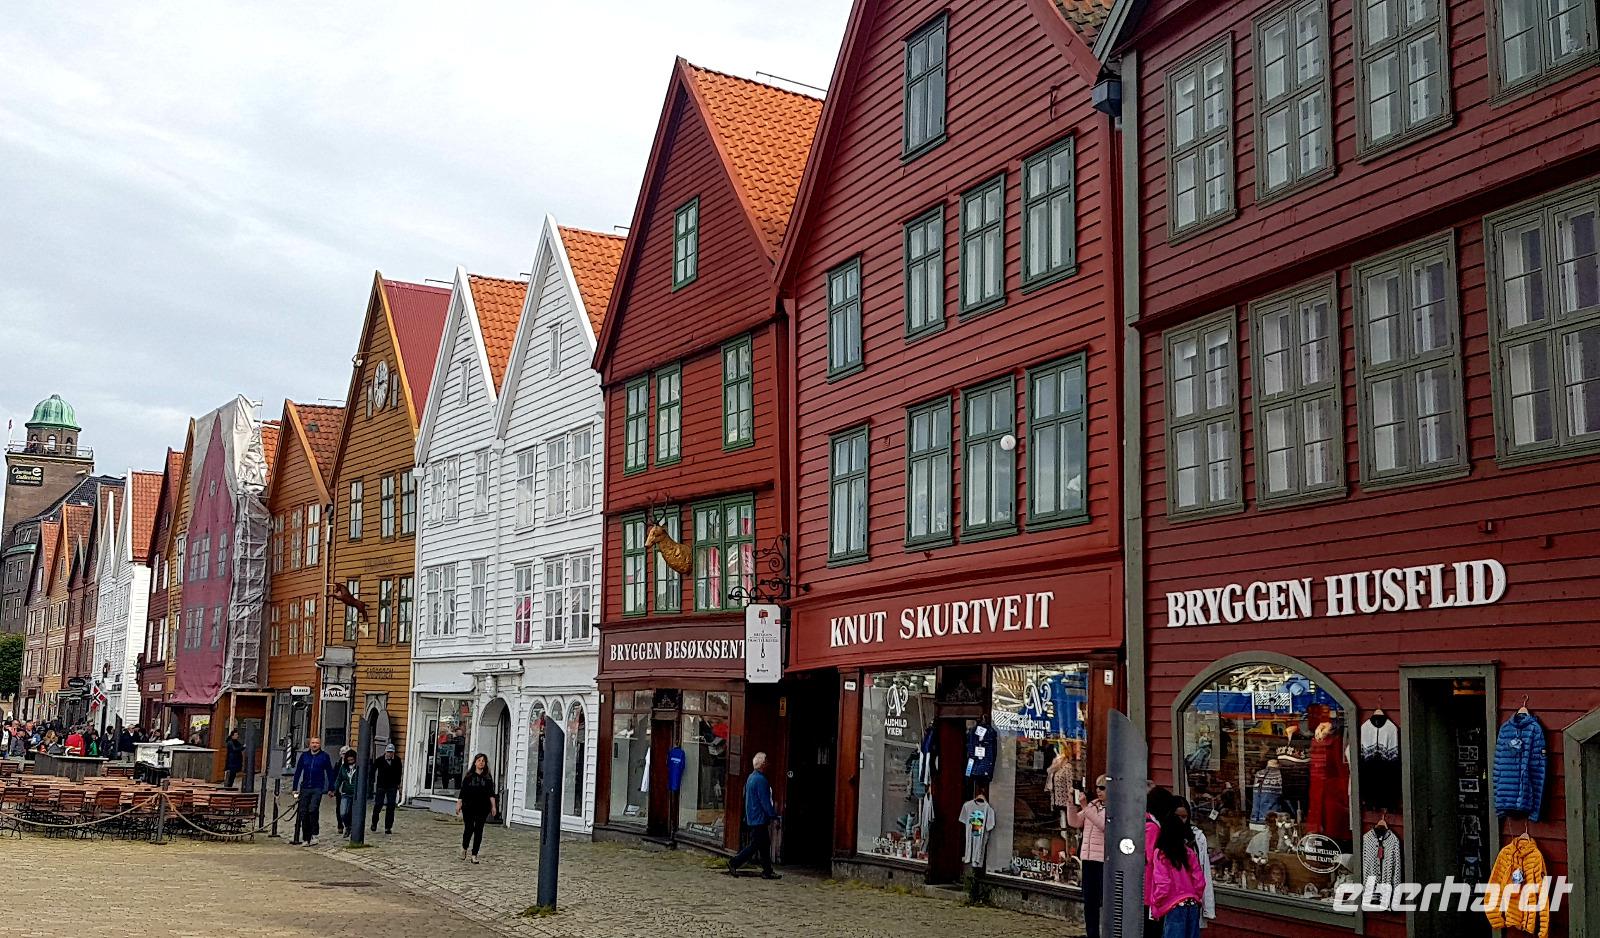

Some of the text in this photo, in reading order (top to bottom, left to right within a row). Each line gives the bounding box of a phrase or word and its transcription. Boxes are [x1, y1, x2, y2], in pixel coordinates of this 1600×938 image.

[829, 591, 1055, 649] KNUT SKURTVEIT
[1165, 558, 1507, 628] BRYGGEN HUSFLID
[610, 642, 661, 661] BRYGGEN
